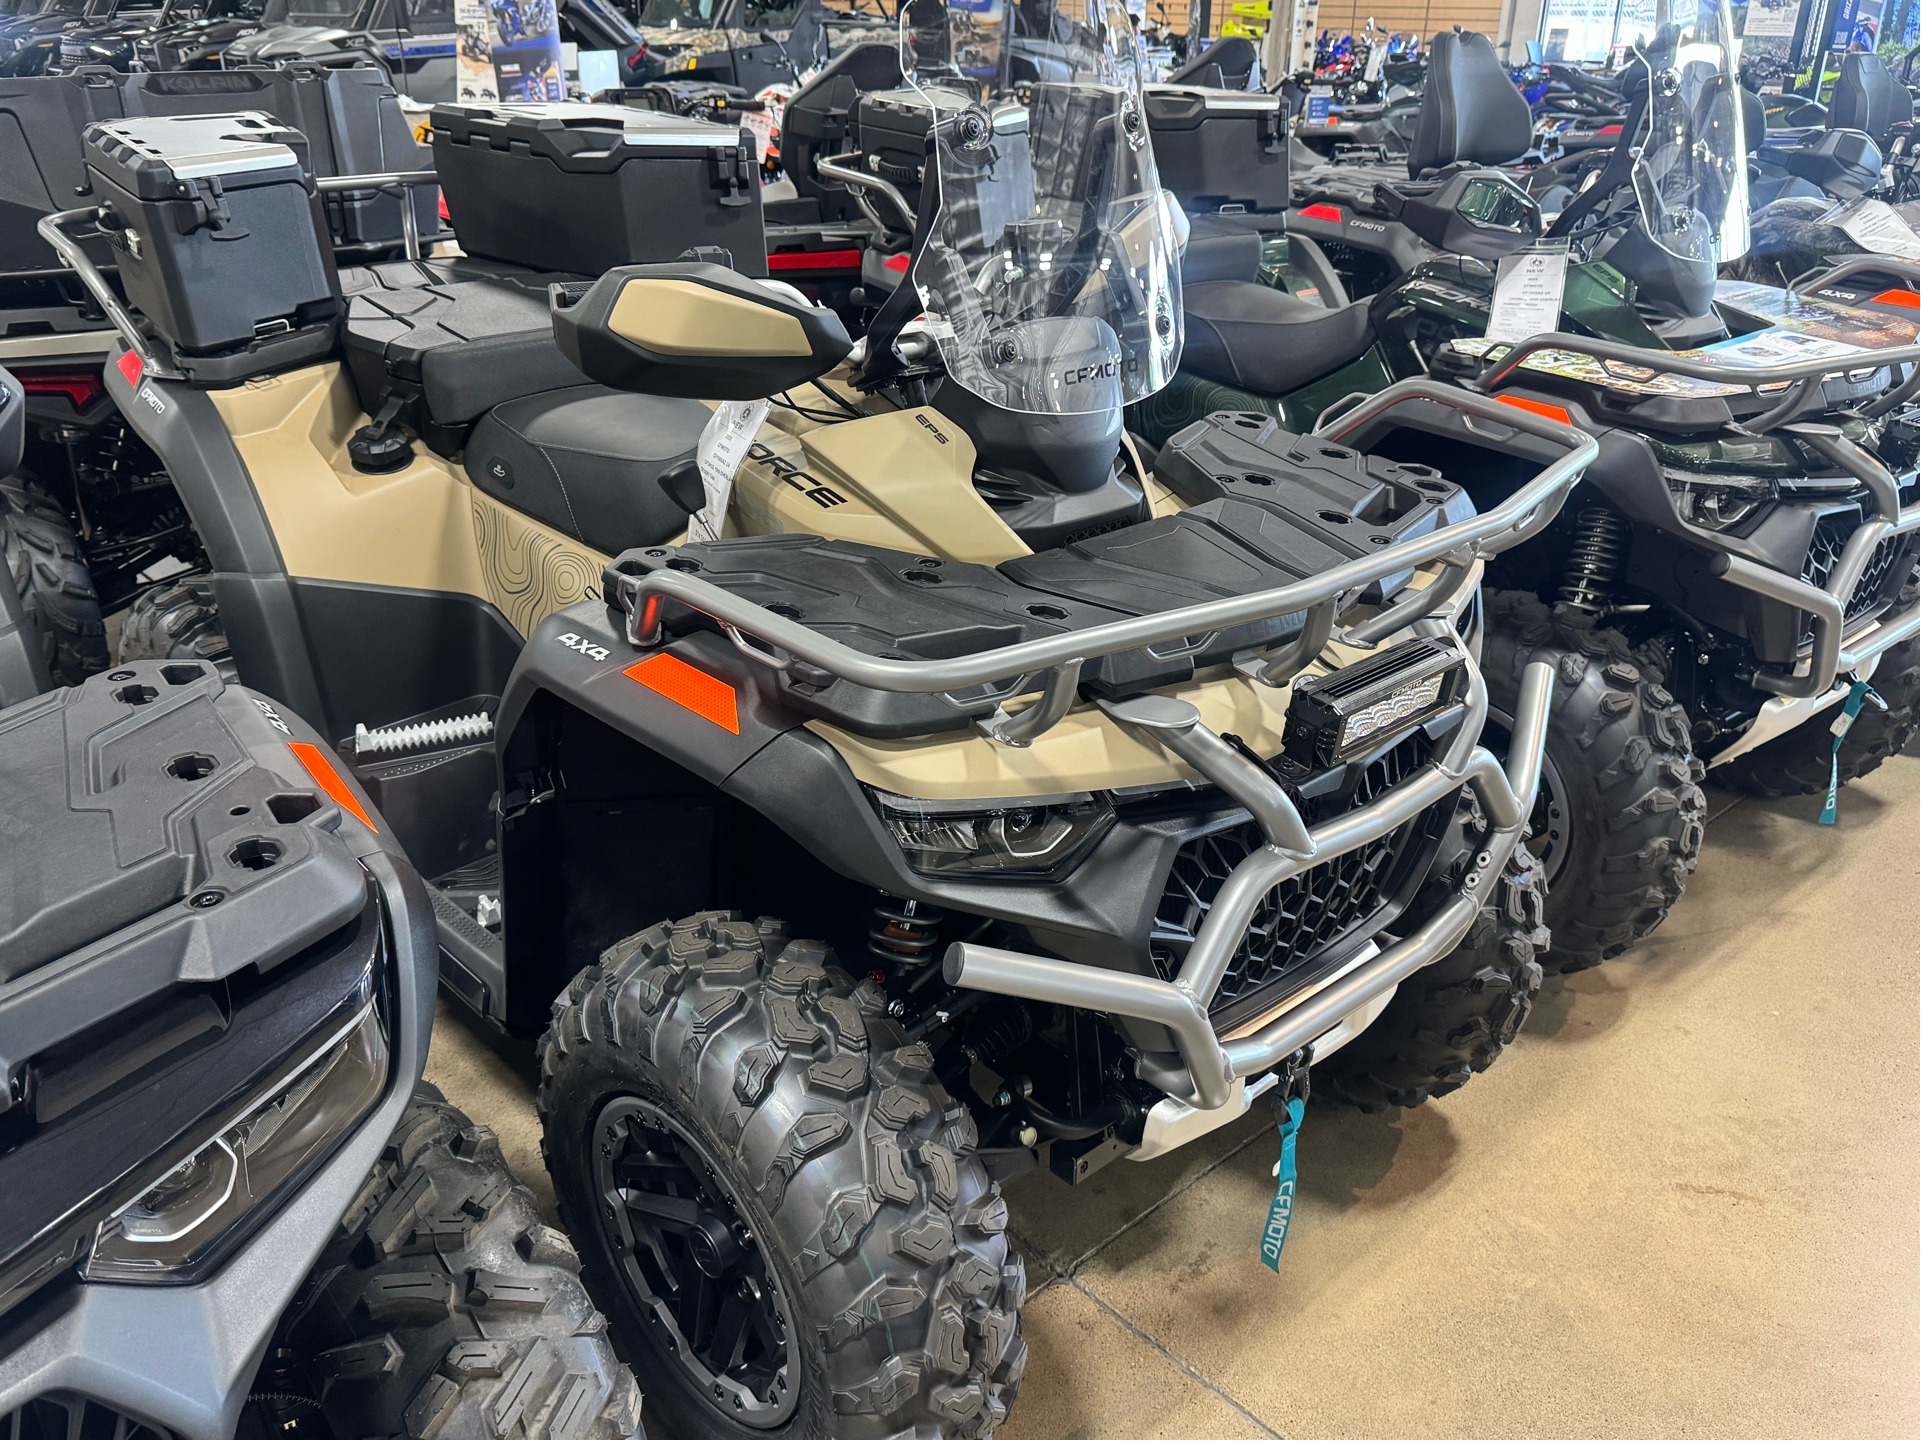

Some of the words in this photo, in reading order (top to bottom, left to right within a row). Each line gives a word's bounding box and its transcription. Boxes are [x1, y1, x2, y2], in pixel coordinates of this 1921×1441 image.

[236, 28, 258, 36] ADV
[160, 74, 250, 94] KOLPIN
[1349, 219, 1385, 232] CFMOTO
[1592, 263, 1620, 284] EPS
[1818, 289, 1857, 300] 4X4
[141, 387, 165, 414] CFMOTO
[915, 414, 949, 444] EPS
[748, 439, 848, 509] ORCE
[554, 633, 611, 661] 4X4
[1391, 680, 1422, 698] CFMOTO
[252, 698, 291, 735] 4X4
[1262, 1180, 1293, 1259] CFMOTO
